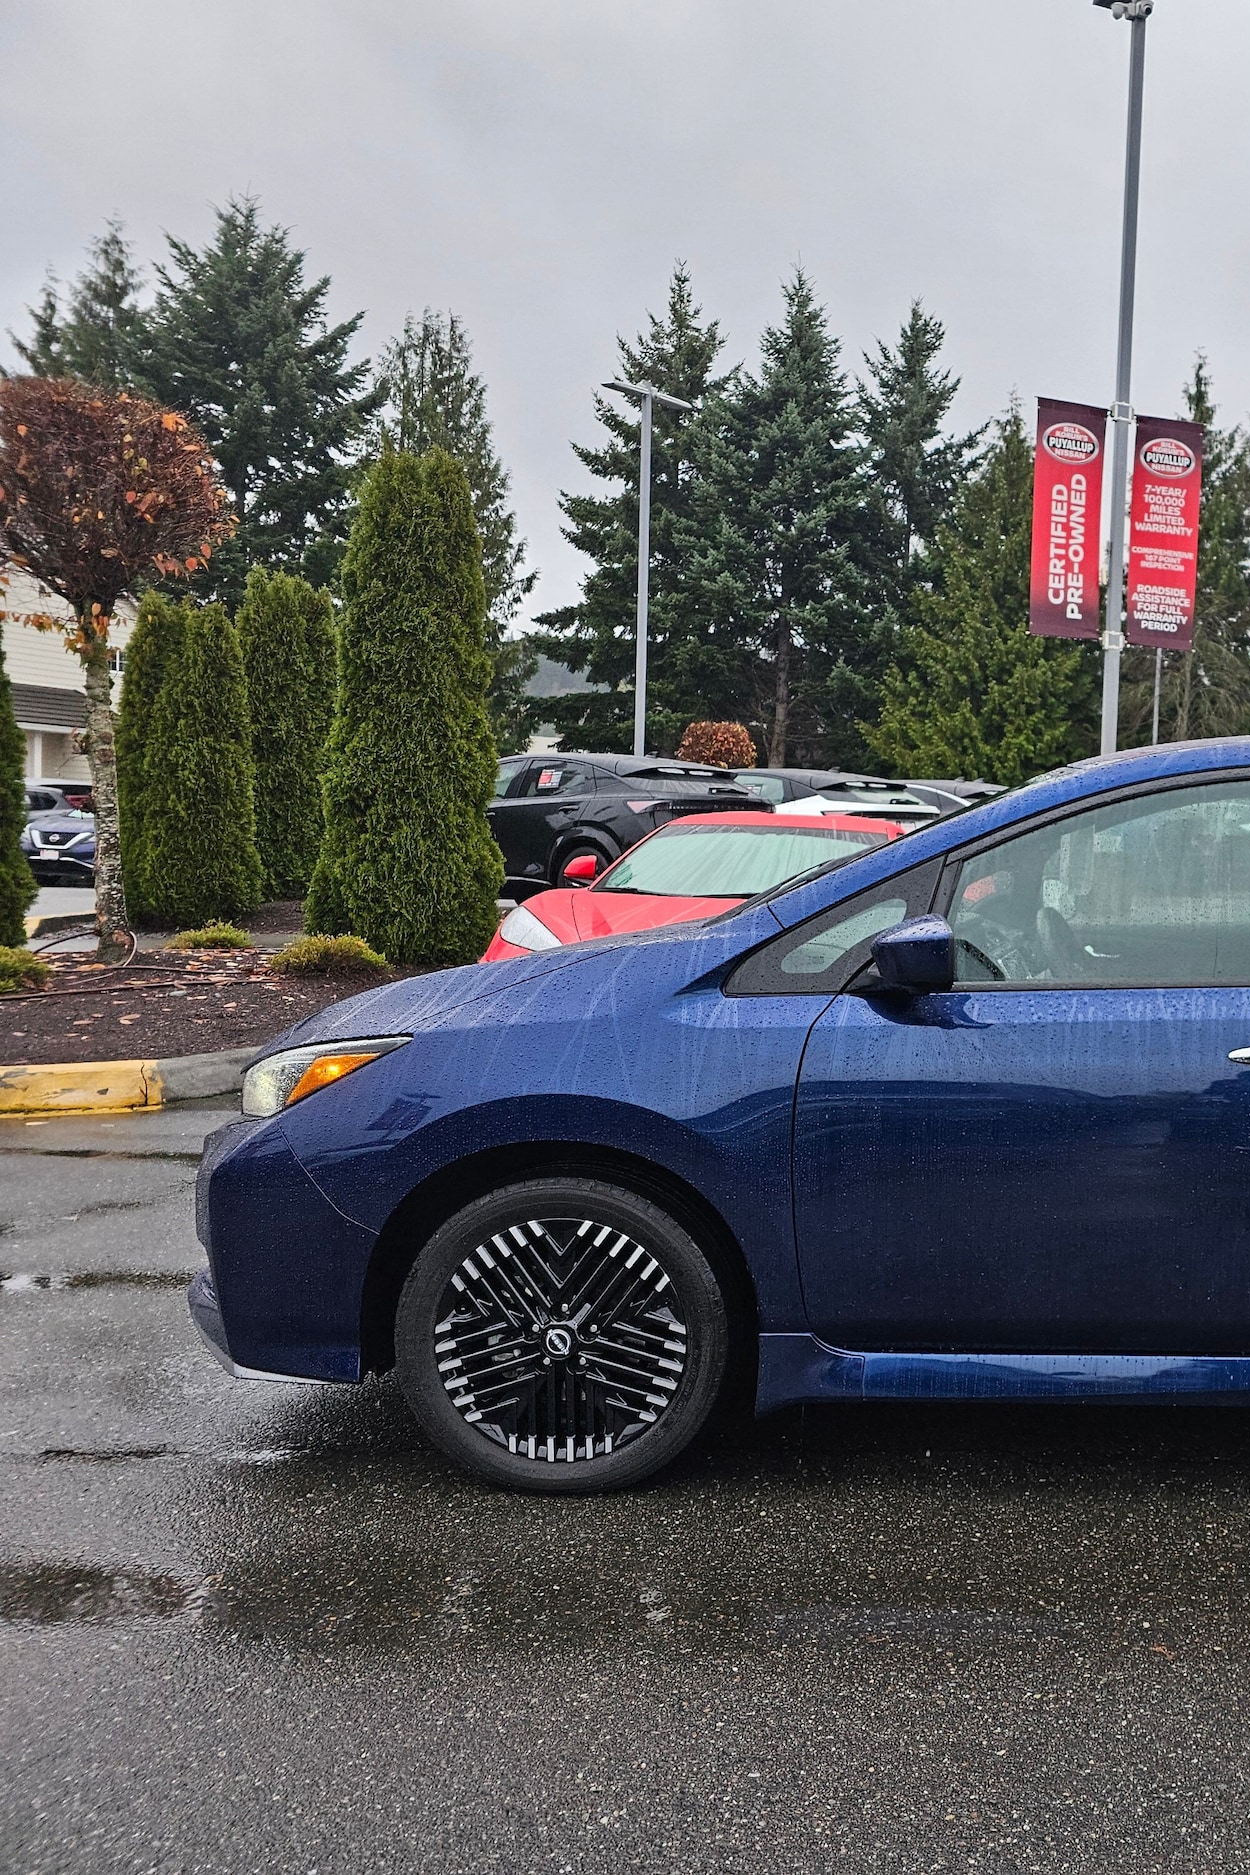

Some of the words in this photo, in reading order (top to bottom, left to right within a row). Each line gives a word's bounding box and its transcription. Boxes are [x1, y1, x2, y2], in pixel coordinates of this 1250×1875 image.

[1049, 436, 1094, 453] PUYALLUP
[1055, 448, 1086, 459] NISSAN
[1146, 452, 1190, 467] PUYALLUP
[1151, 463, 1182, 473] NISSAN
[1145, 484, 1187, 498] 7-YEAR/
[1143, 494, 1186, 508] 100,000
[1149, 504, 1181, 516] MILES
[1144, 512, 1185, 526] LIMITED
[1134, 521, 1193, 537] WARRANTY
[1048, 484, 1068, 604] CERTIFIED
[1066, 473, 1087, 620] PRE-OWNED
[1131, 546, 1194, 560] COMPREHENSIVE
[1140, 560, 1184, 572] INSPECTION
[1137, 584, 1186, 597] ROADSIDE
[1131, 592, 1190, 607] ASSISTANCE
[1137, 602, 1158, 612] FOR
[1159, 604, 1183, 615] FULL
[1133, 610, 1188, 624] WARRANTY
[1141, 620, 1178, 632] PERIOD
